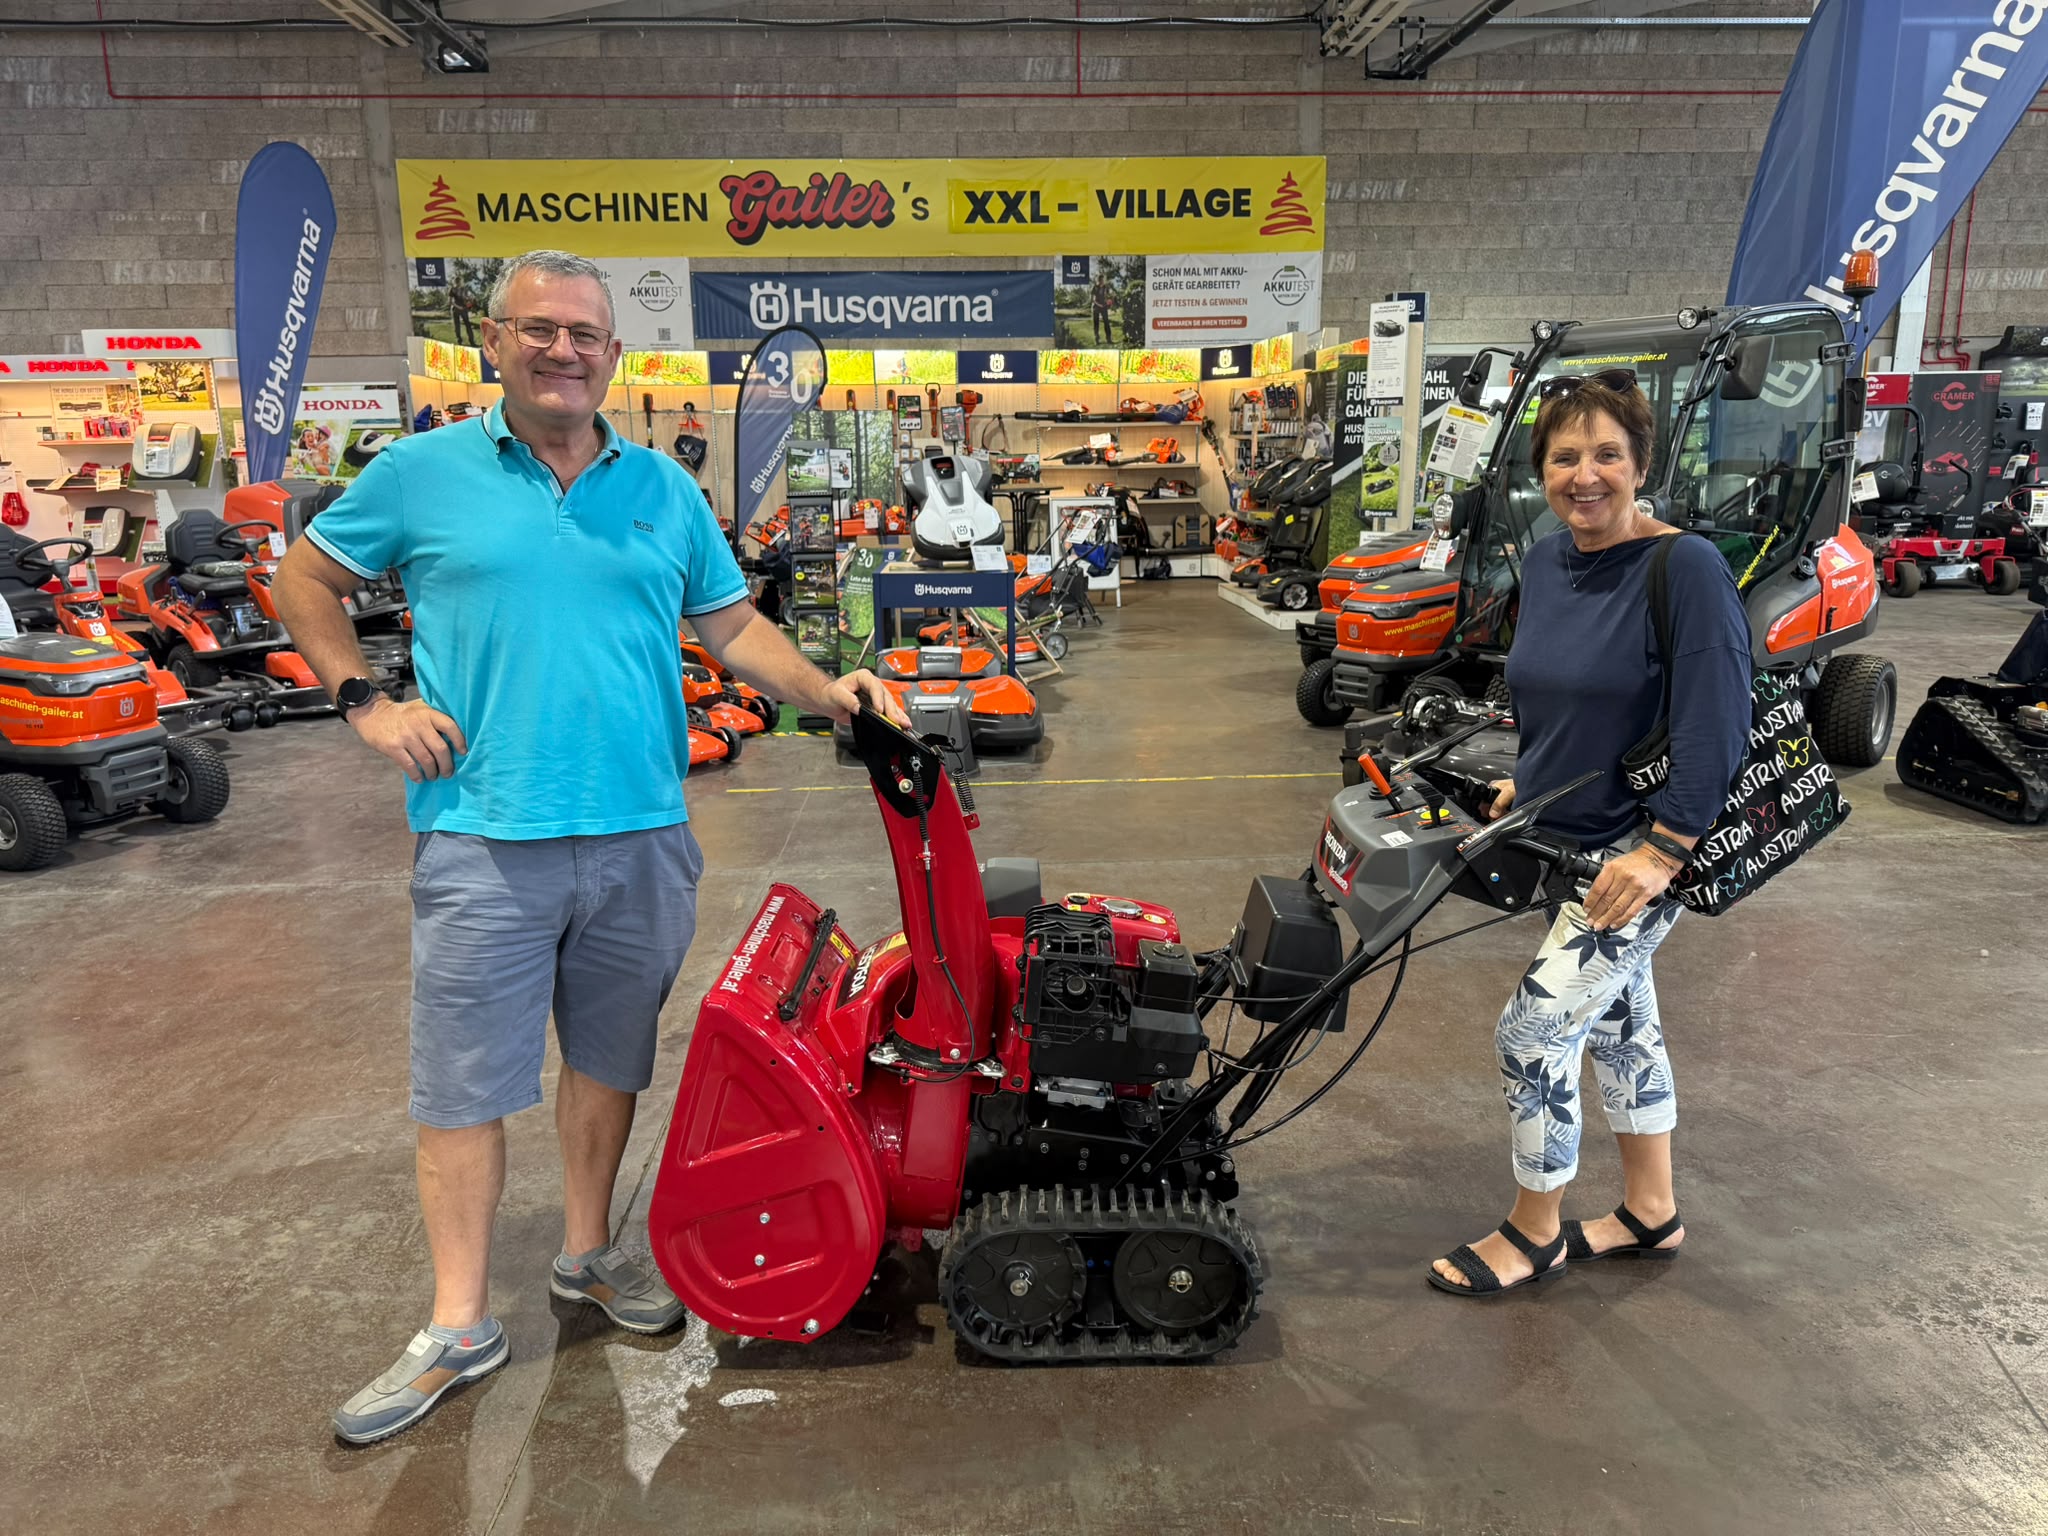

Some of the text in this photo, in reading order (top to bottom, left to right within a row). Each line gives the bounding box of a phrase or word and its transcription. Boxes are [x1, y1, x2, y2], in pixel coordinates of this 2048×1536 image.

[476, 192, 708, 223] MASCHINEN
[963, 189, 1050, 225] XXL
[1095, 187, 1252, 219] VILLAGE
[1152, 265, 1248, 278] SCHON MAL MIT AKKU-
[629, 286, 684, 298] AKKUTEST
[1152, 279, 1241, 291] GERÄTE GEARBEITET?
[1263, 280, 1316, 293] AKKUTEST
[266, 217, 322, 393] Husqvarna
[793, 287, 994, 330] Husqvarna
[1152, 297, 1248, 308] JETZT TESTEN & GEWINNEN
[105, 336, 203, 350] HONDA
[27, 360, 109, 373] HONDA
[1562, 352, 1669, 367] www.maschinen-gailer.at
[1347, 371, 1367, 385] DIE
[1933, 391, 1976, 401] CRAMER
[303, 399, 383, 411] HONDA
[633, 519, 655, 534] BOSS
[924, 583, 972, 596] Husqvarna
[1749, 700, 1804, 749] AUSTA
[1325, 830, 1347, 864] HONDA
[1746, 820, 1809, 879] AUSTRIA
[719, 895, 786, 994] www.maschinen-gailer.at
